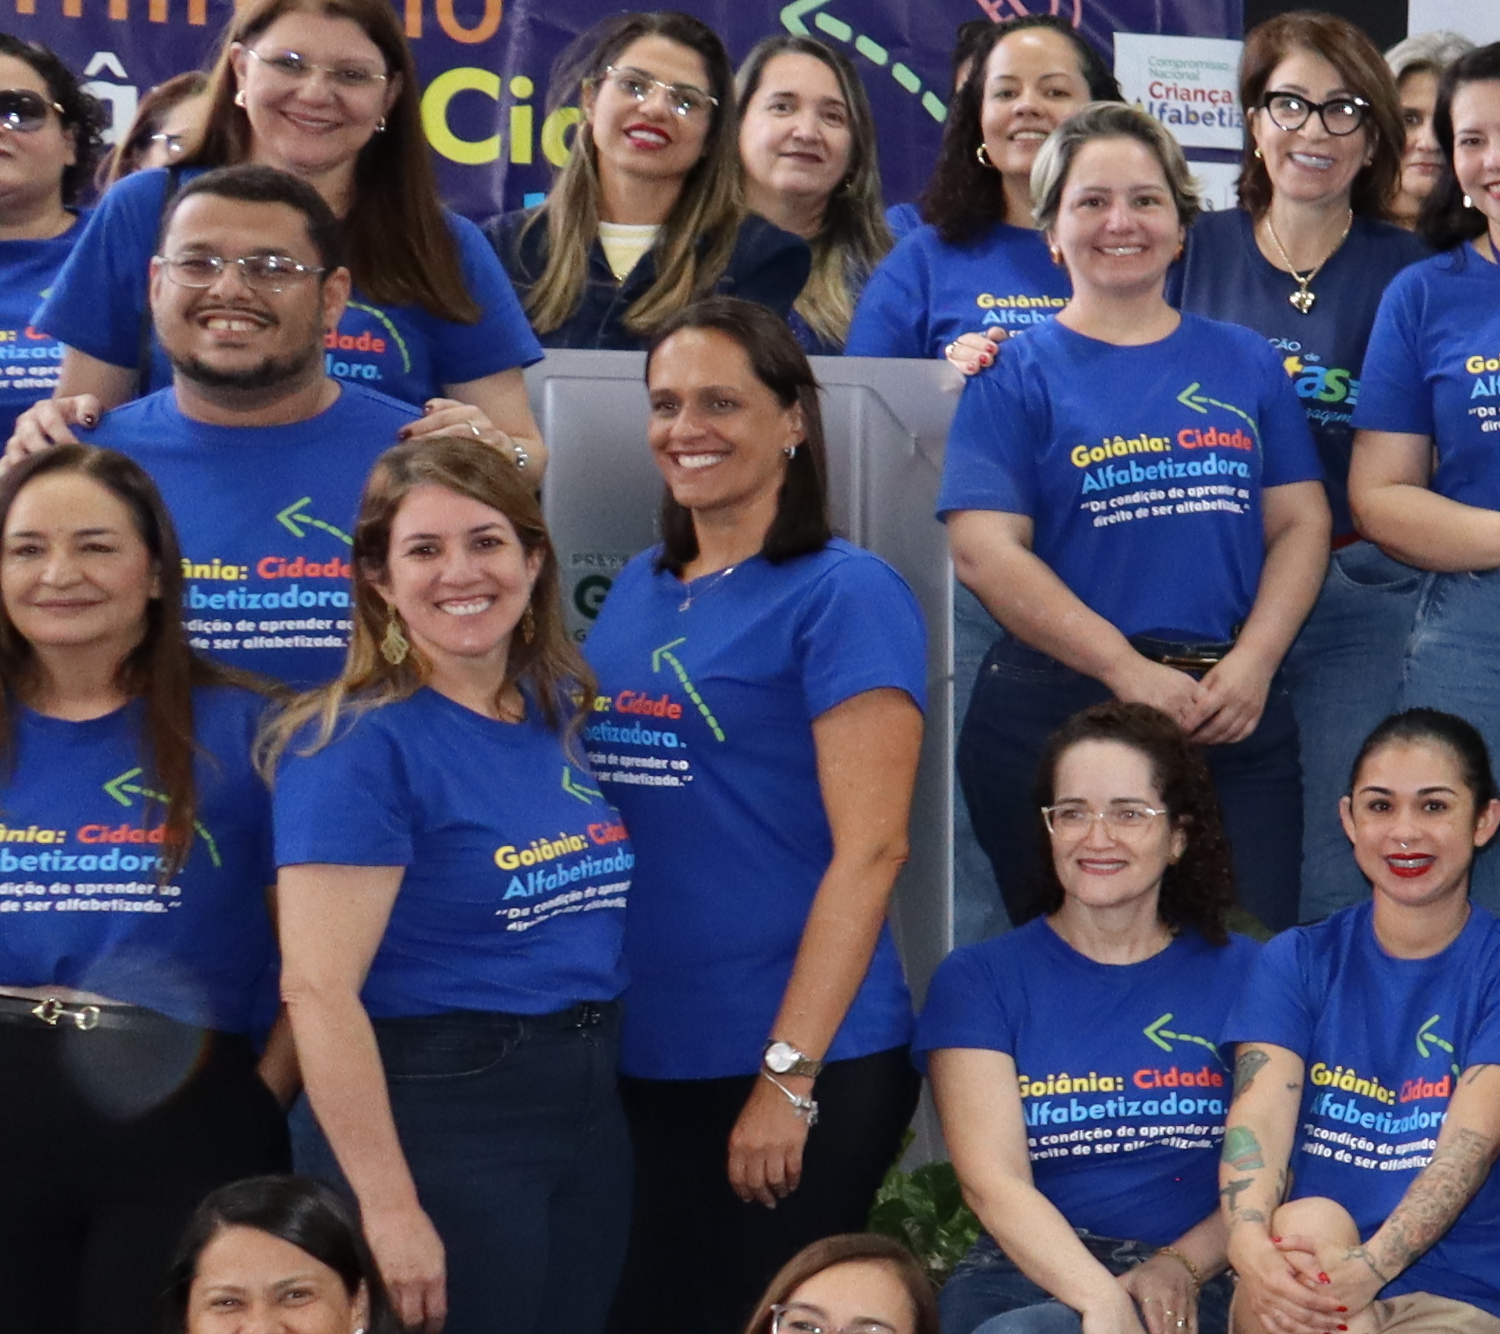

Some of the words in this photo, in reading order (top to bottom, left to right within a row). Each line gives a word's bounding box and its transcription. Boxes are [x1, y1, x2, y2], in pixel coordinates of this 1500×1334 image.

[1148, 80, 1233, 108] Criança
[1147, 101, 1244, 128] lfabetiz
[1071, 435, 1171, 468] Goiânia:
[1177, 428, 1253, 451] Cidade
[1082, 453, 1251, 494] Alfabetizadora.
[616, 690, 683, 720] Cidade
[494, 833, 588, 870] Goiânia:
[1133, 1066, 1223, 1090] Cidade
